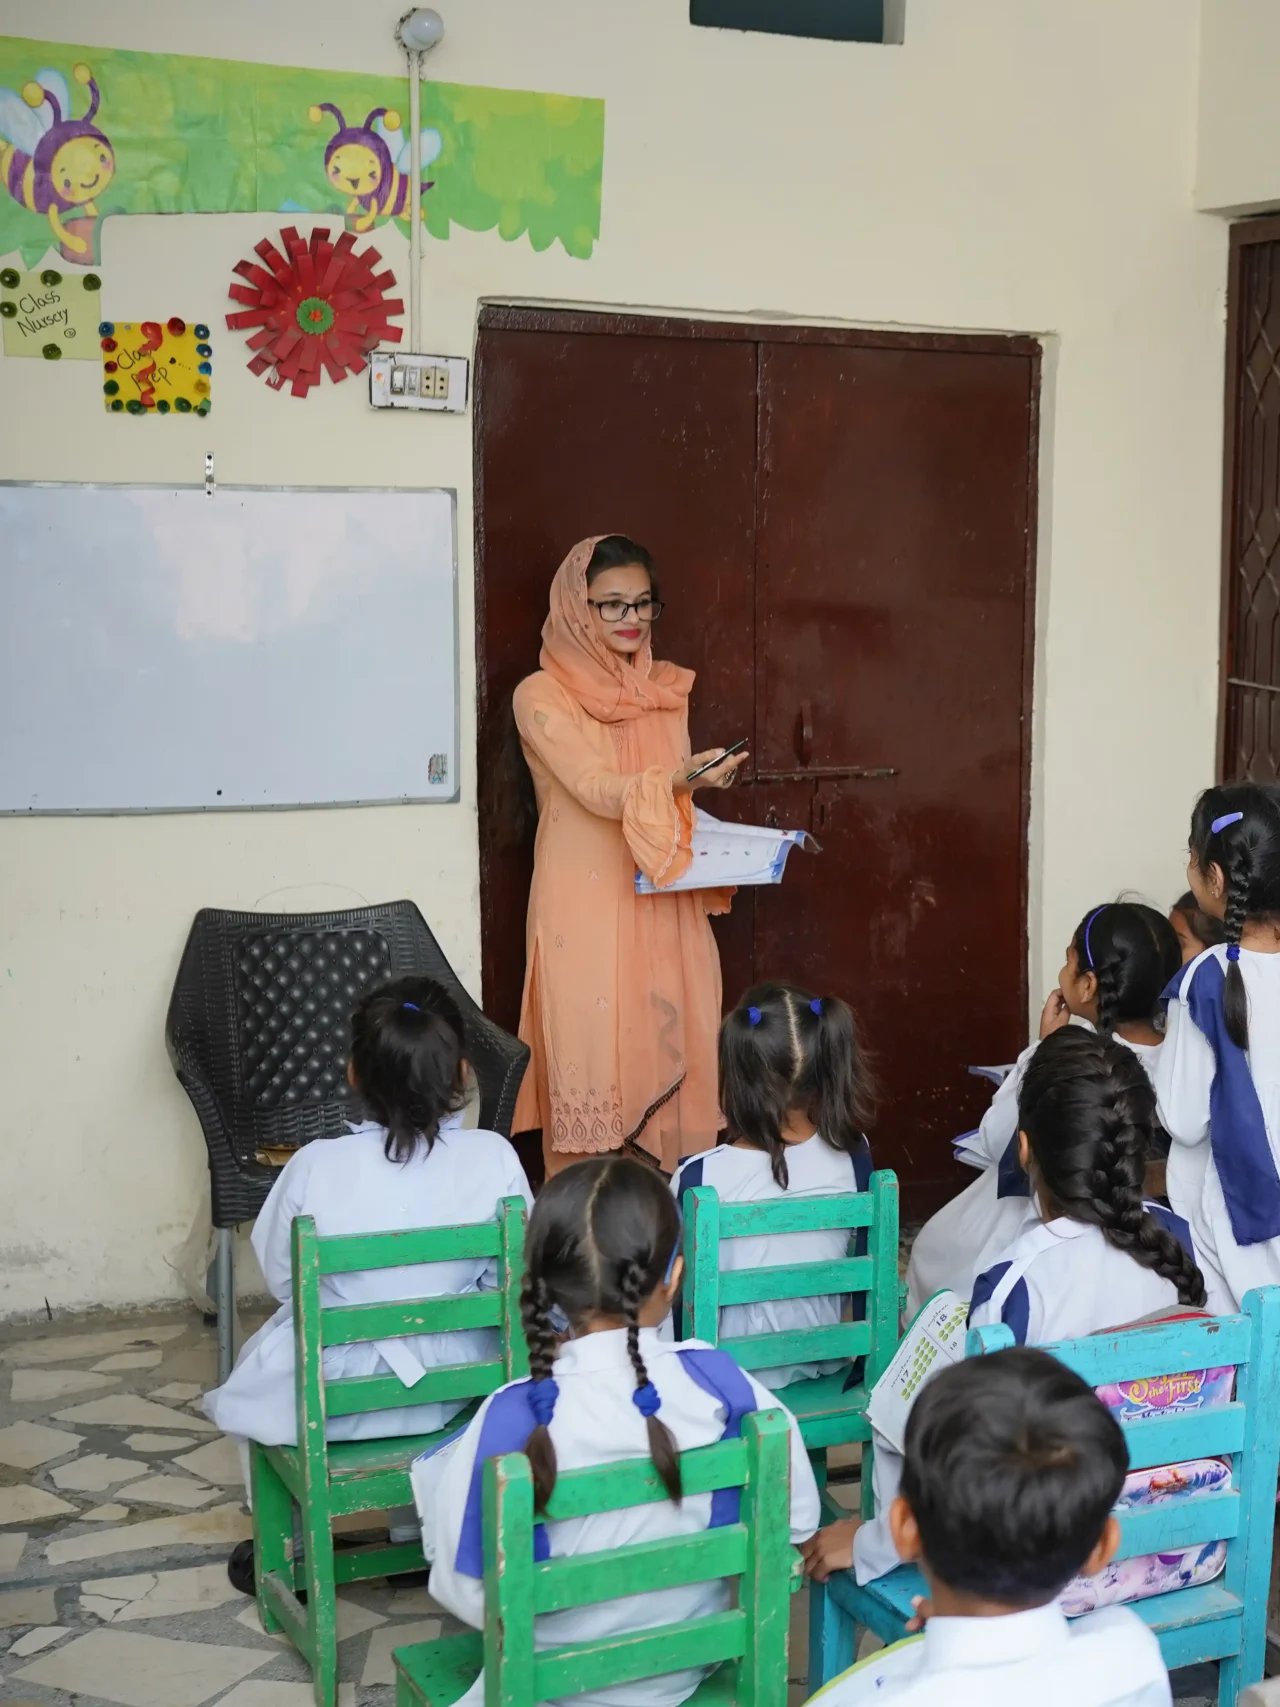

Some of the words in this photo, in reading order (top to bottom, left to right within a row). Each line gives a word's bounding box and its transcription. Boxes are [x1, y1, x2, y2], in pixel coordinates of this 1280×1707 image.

[19, 290, 61, 314] Class
[17, 308, 68, 337] Nursery
[117, 348, 152, 370] Cla
[131, 367, 172, 392] Pep
[936, 1313, 948, 1327] 18
[900, 1369, 909, 1384] 17
